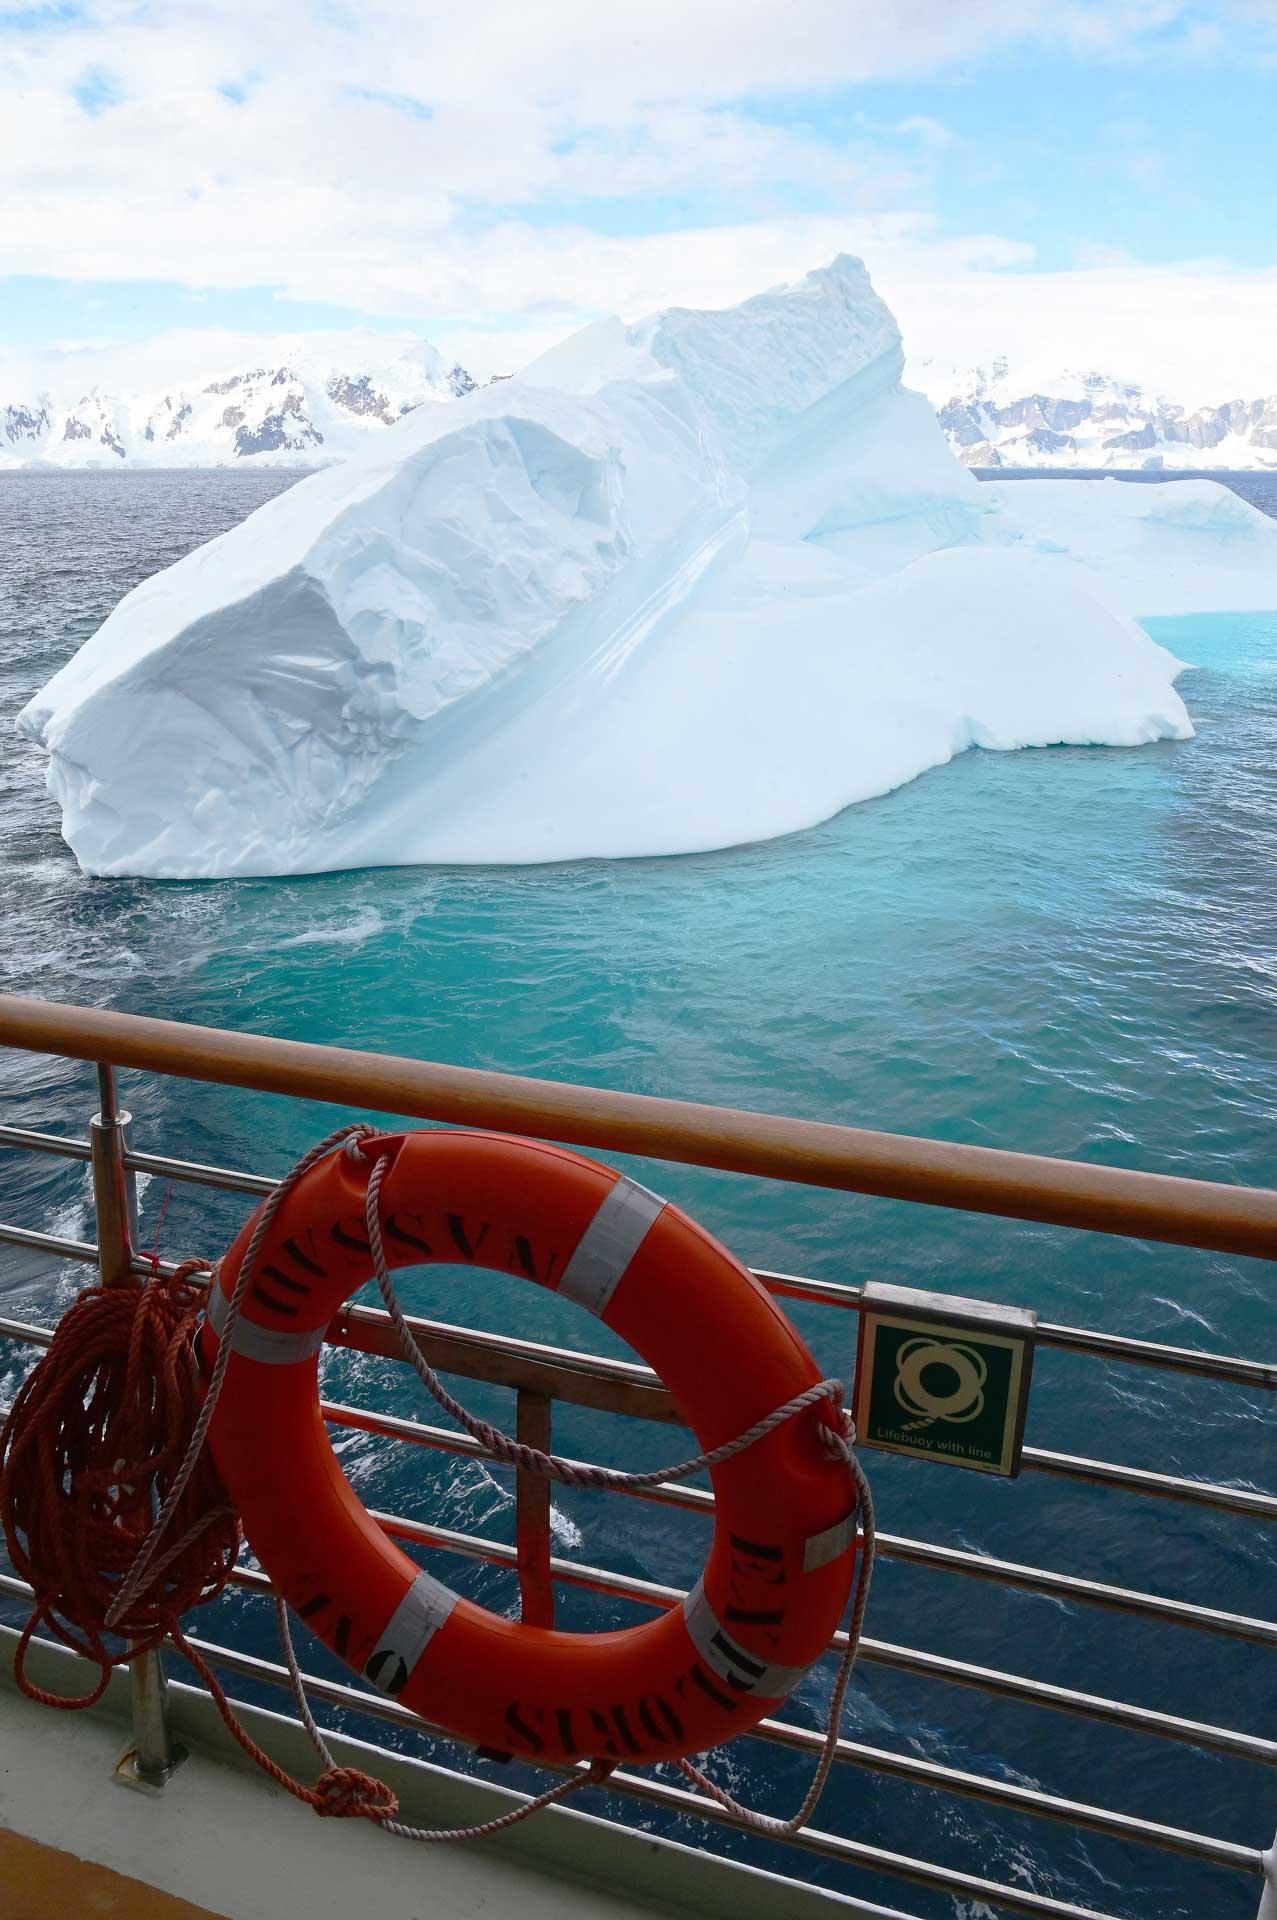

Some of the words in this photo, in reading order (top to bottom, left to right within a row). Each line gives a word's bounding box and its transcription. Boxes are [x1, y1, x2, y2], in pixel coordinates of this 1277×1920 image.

[252, 1212, 559, 1317] NASSAU
[877, 1427, 933, 1449] Lifebuoy
[936, 1440, 965, 1454] with
[969, 1446, 992, 1459] line
